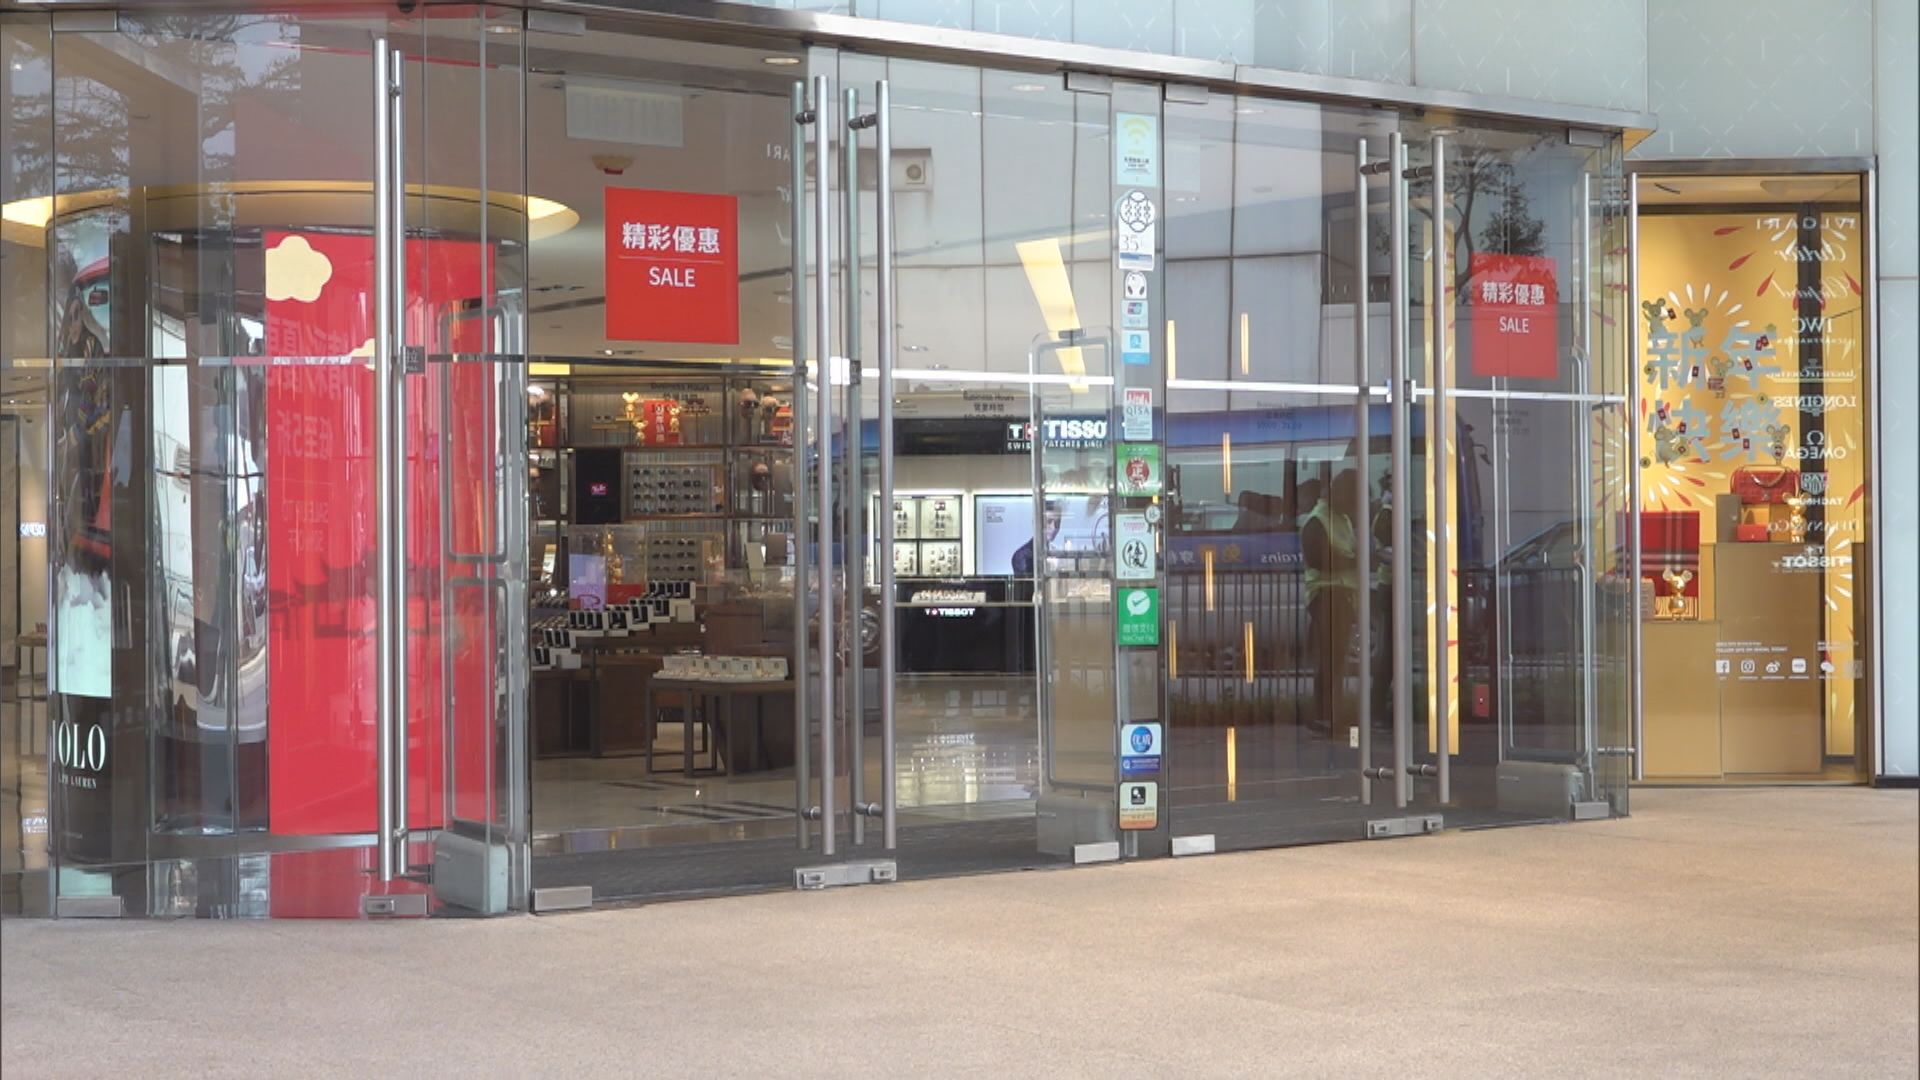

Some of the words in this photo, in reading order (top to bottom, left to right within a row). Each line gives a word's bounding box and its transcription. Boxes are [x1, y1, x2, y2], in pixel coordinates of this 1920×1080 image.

[622, 222, 720, 253] 精彩優惠
[649, 266, 696, 287] SALE
[1482, 281, 1545, 305] 精彩優惠
[1499, 316, 1529, 333] SALE
[1647, 324, 1782, 390] 新年
